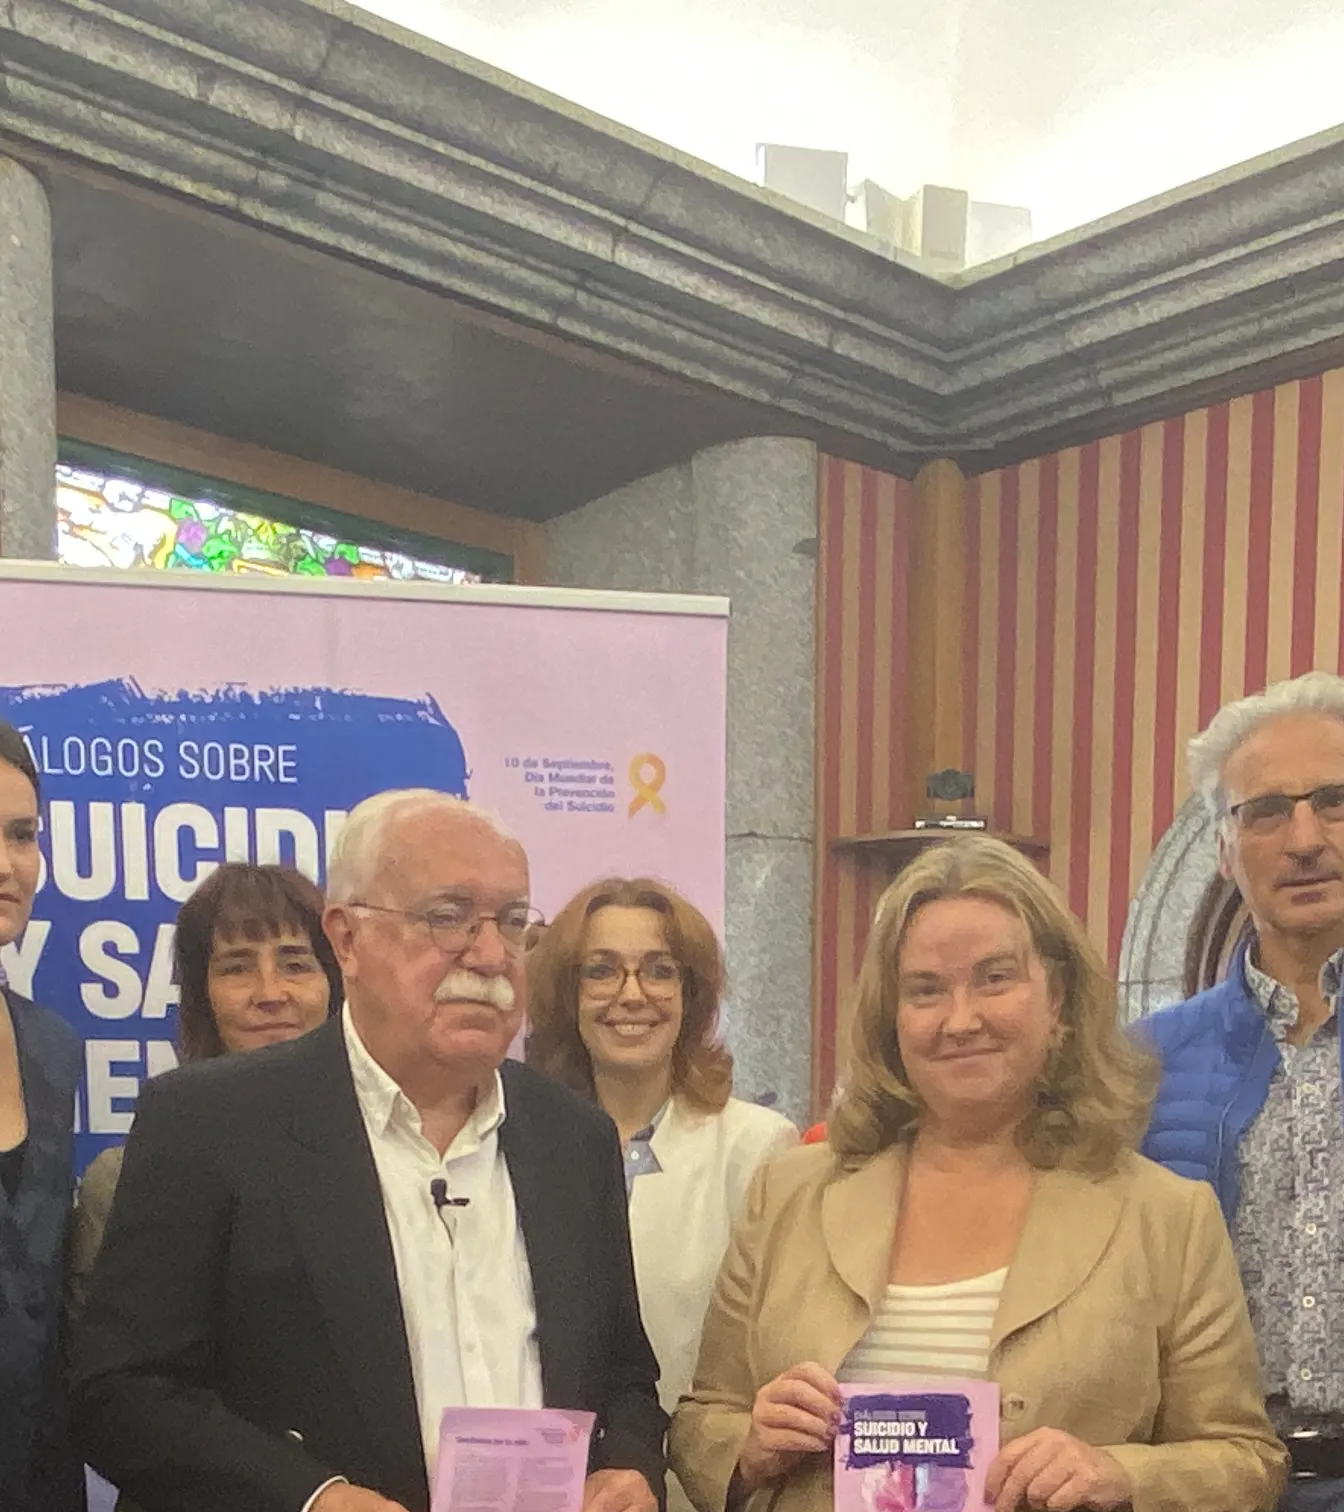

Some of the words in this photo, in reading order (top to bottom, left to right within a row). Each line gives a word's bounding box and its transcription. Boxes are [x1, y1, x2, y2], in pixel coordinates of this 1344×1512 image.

[18, 725, 165, 779] ÁLOGOS
[179, 740, 299, 783] SOBRE
[505, 757, 520, 768] 10
[522, 757, 538, 768] de
[548, 772, 597, 783] Mundial
[534, 786, 545, 797] la
[544, 800, 564, 811] del
[567, 800, 615, 812] Suicidio
[37, 800, 352, 902] UICID
[854, 1421, 916, 1437] SUICIDIO
[917, 1421, 928, 1437] Y
[854, 1438, 900, 1454] SALUD
[903, 1438, 960, 1454] MENTAL
